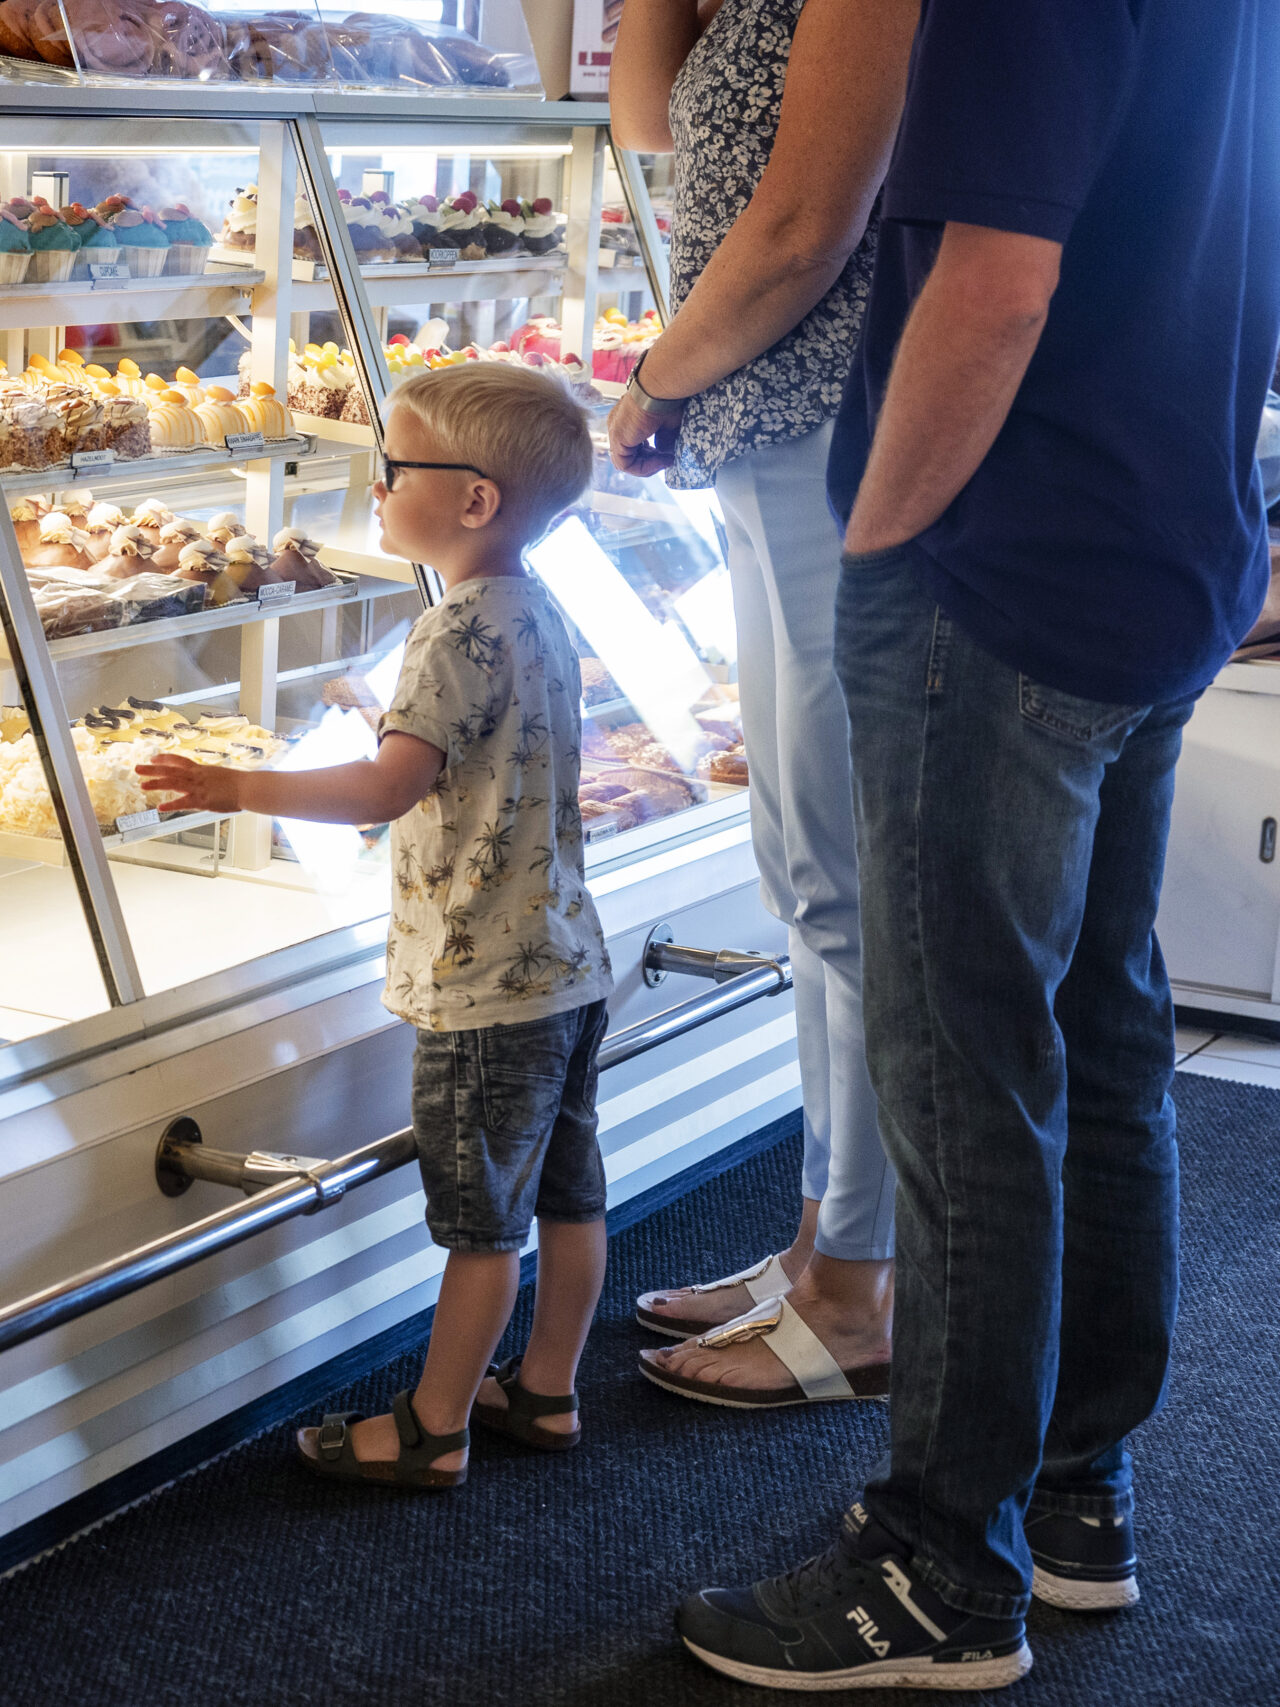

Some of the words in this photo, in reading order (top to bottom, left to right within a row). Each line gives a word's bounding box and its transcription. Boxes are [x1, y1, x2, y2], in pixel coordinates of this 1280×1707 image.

[80, 454, 107, 463] HAZELNOOT
[850, 1502, 869, 1524] FILA
[846, 1605, 891, 1659] FILA
[961, 1649, 994, 1662] FILA
